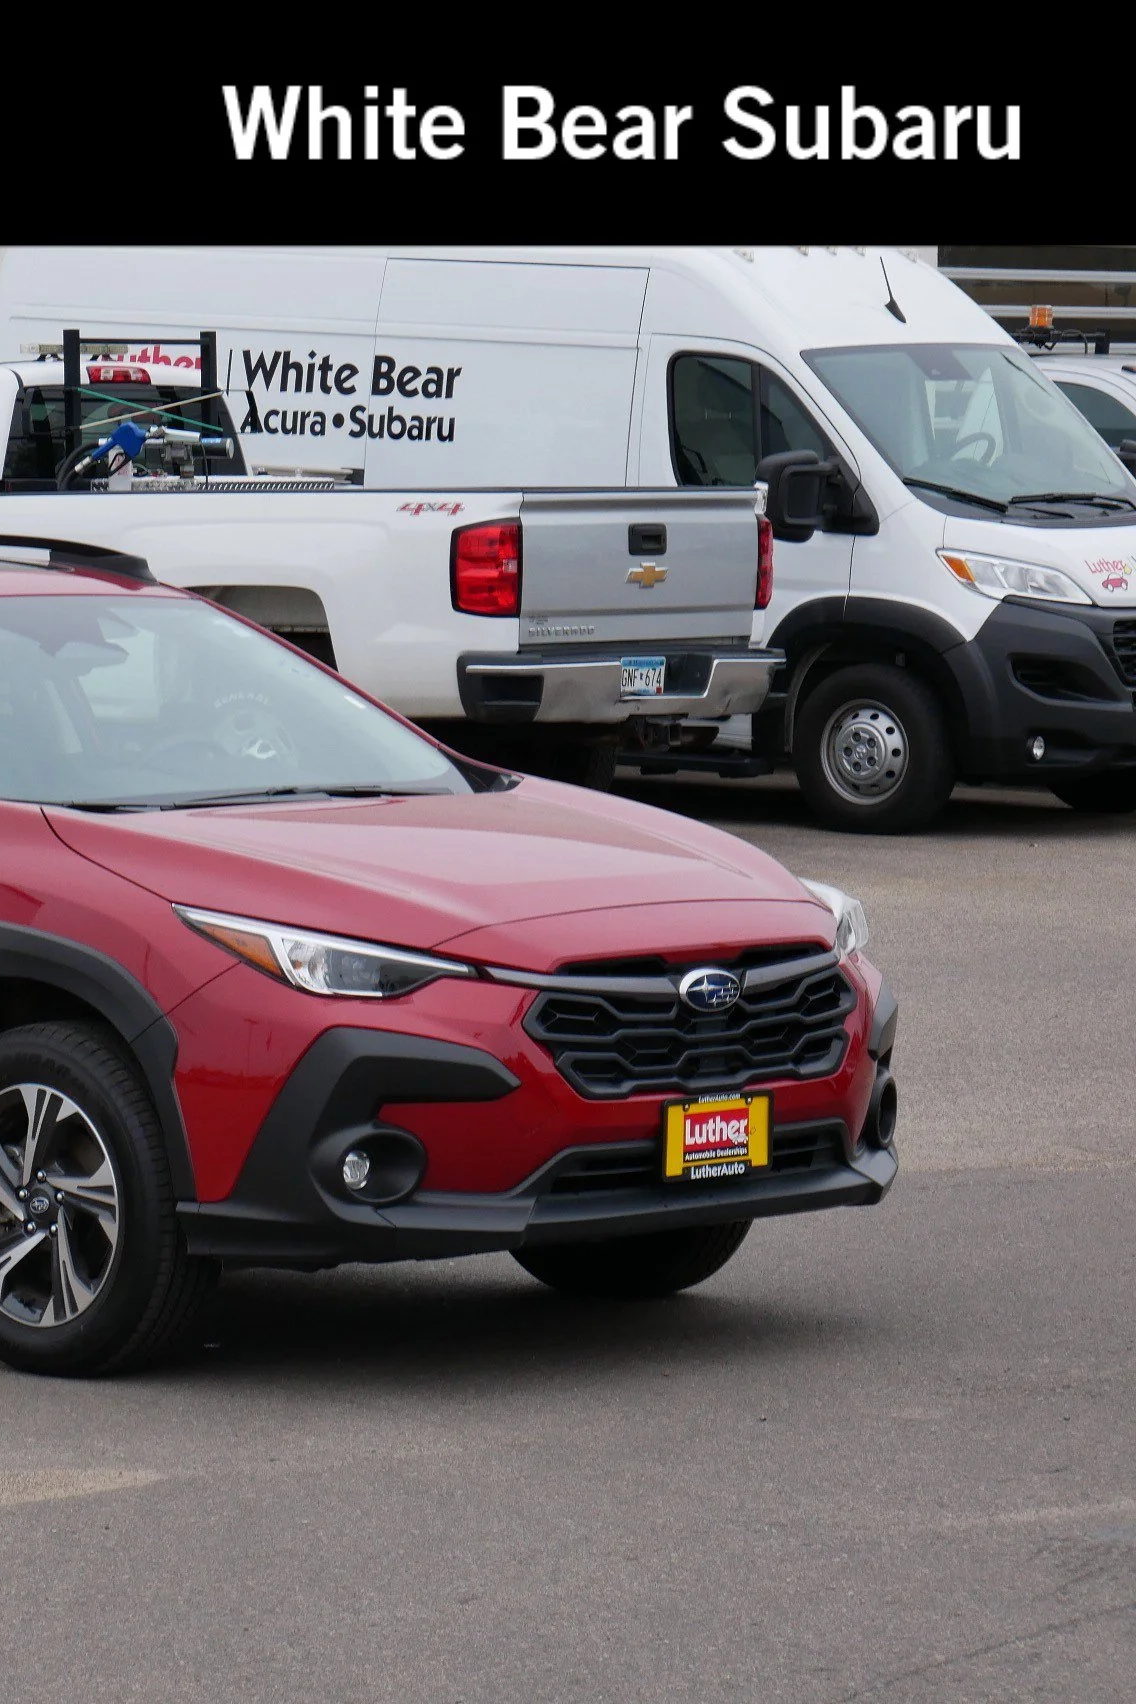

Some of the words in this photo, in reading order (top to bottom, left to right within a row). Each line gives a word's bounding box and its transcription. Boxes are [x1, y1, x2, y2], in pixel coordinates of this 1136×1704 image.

[242, 349, 360, 395] White
[371, 354, 462, 398] Bear
[685, 1115, 749, 1146] Luther
[684, 1149, 716, 1161] Automobile
[716, 1146, 748, 1158] Dealerships
[690, 1162, 745, 1180] LutherAuto
